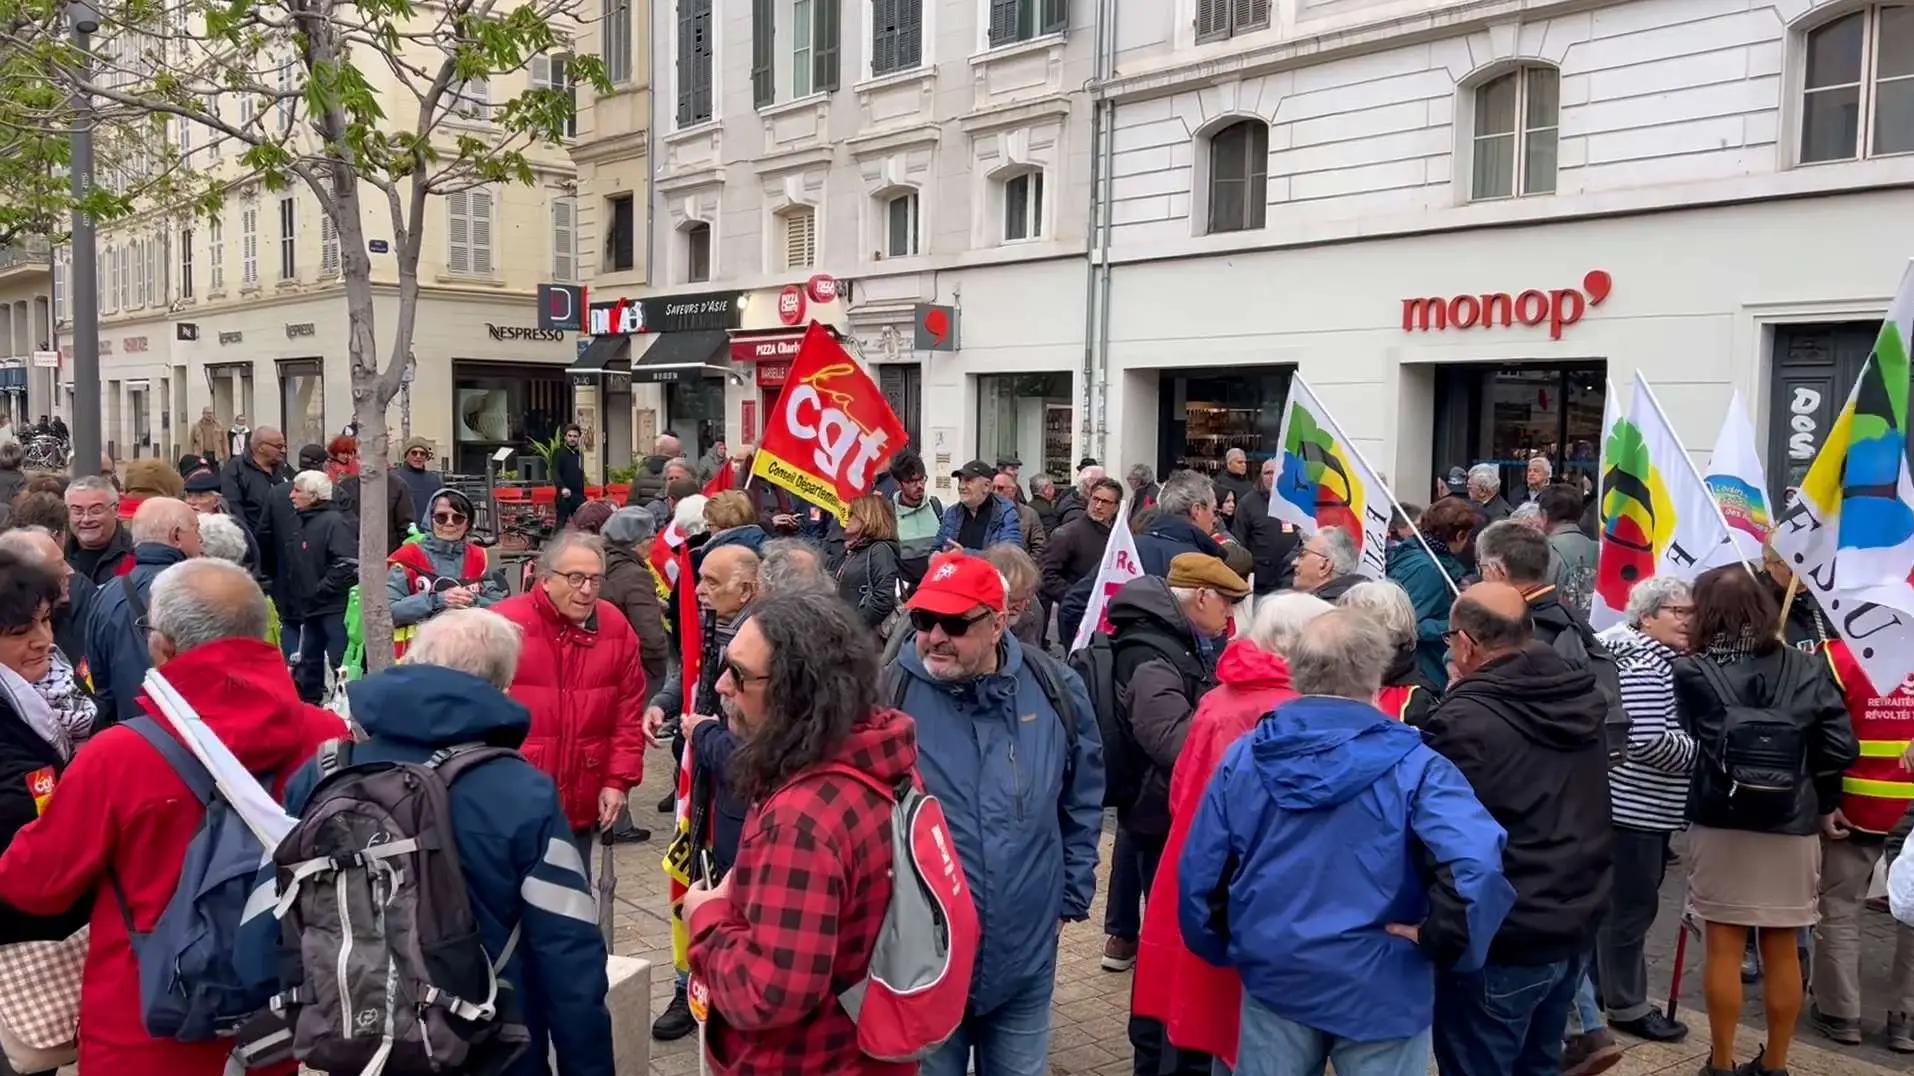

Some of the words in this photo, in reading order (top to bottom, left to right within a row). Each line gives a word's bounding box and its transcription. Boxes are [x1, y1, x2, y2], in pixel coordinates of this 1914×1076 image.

[781, 293, 798, 303] PIZZA
[1401, 270, 1612, 340] monop'
[485, 322, 565, 342] NESPRESSO
[756, 343, 776, 356] PIZZA
[786, 384, 891, 492] cgt
[768, 461, 797, 484] Conseil
